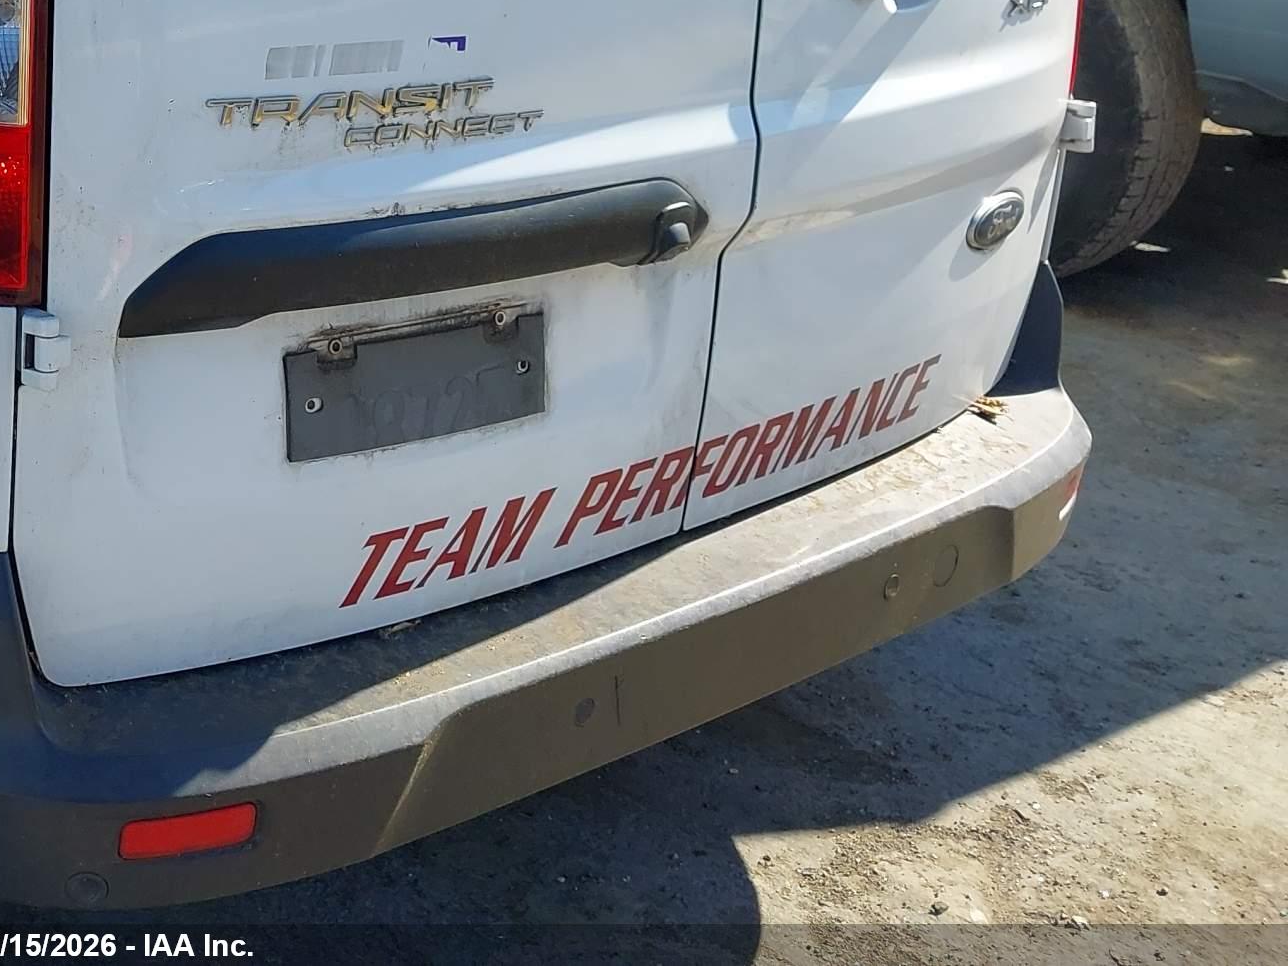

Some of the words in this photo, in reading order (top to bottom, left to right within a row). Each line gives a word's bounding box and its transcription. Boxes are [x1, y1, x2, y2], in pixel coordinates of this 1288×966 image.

[204, 75, 496, 128] TRANSIT
[343, 108, 545, 149] CONNECT
[339, 488, 557, 608] TEAM
[555, 353, 942, 547] PERFORMANCE
